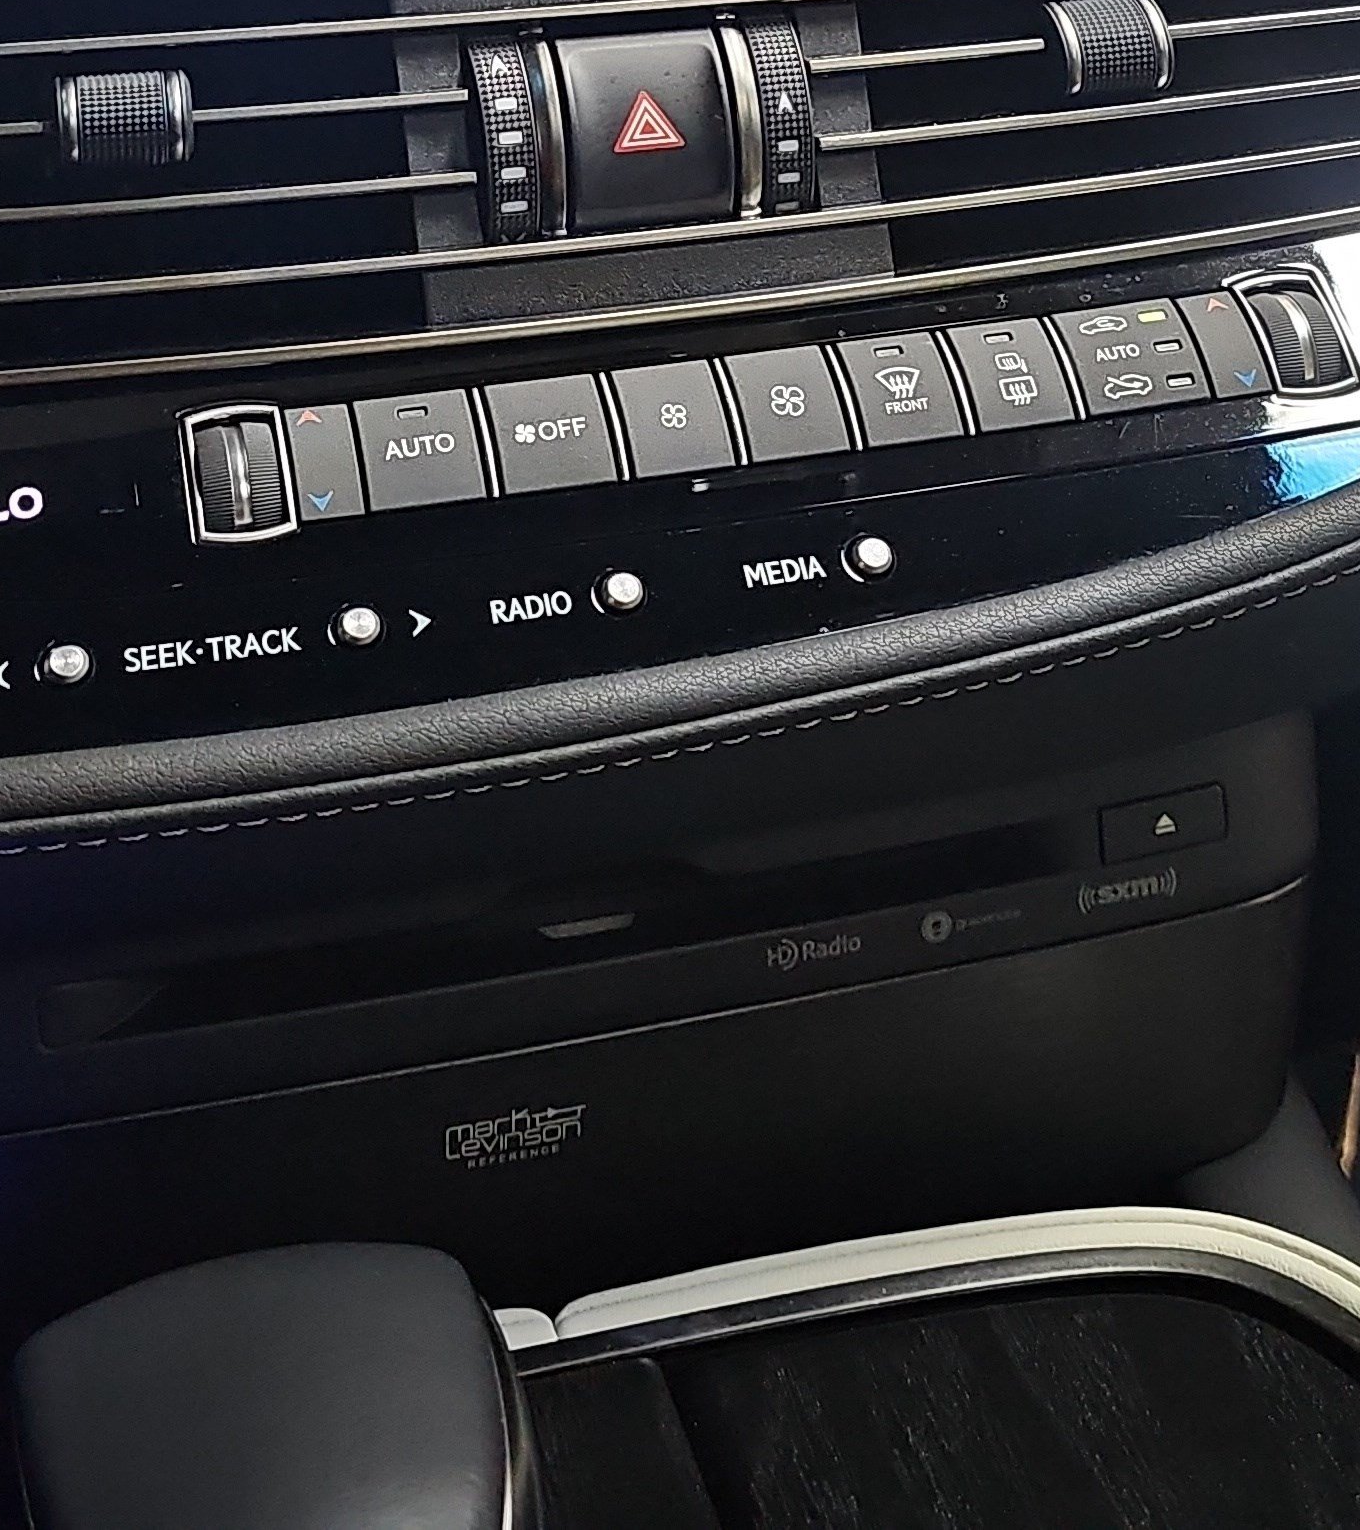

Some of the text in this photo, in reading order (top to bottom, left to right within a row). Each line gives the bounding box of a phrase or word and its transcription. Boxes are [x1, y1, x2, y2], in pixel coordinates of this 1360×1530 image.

[1096, 343, 1140, 362] AUTO
[884, 396, 929, 415] FRONT
[537, 415, 587, 441] OFF
[385, 432, 455, 461] AUTO
[742, 555, 828, 589] MEDIA
[489, 590, 573, 625] RADIO
[1097, 876, 1159, 904] sxm
[802, 934, 861, 962] Radio
[467, 1144, 561, 1170] REFERENCE
